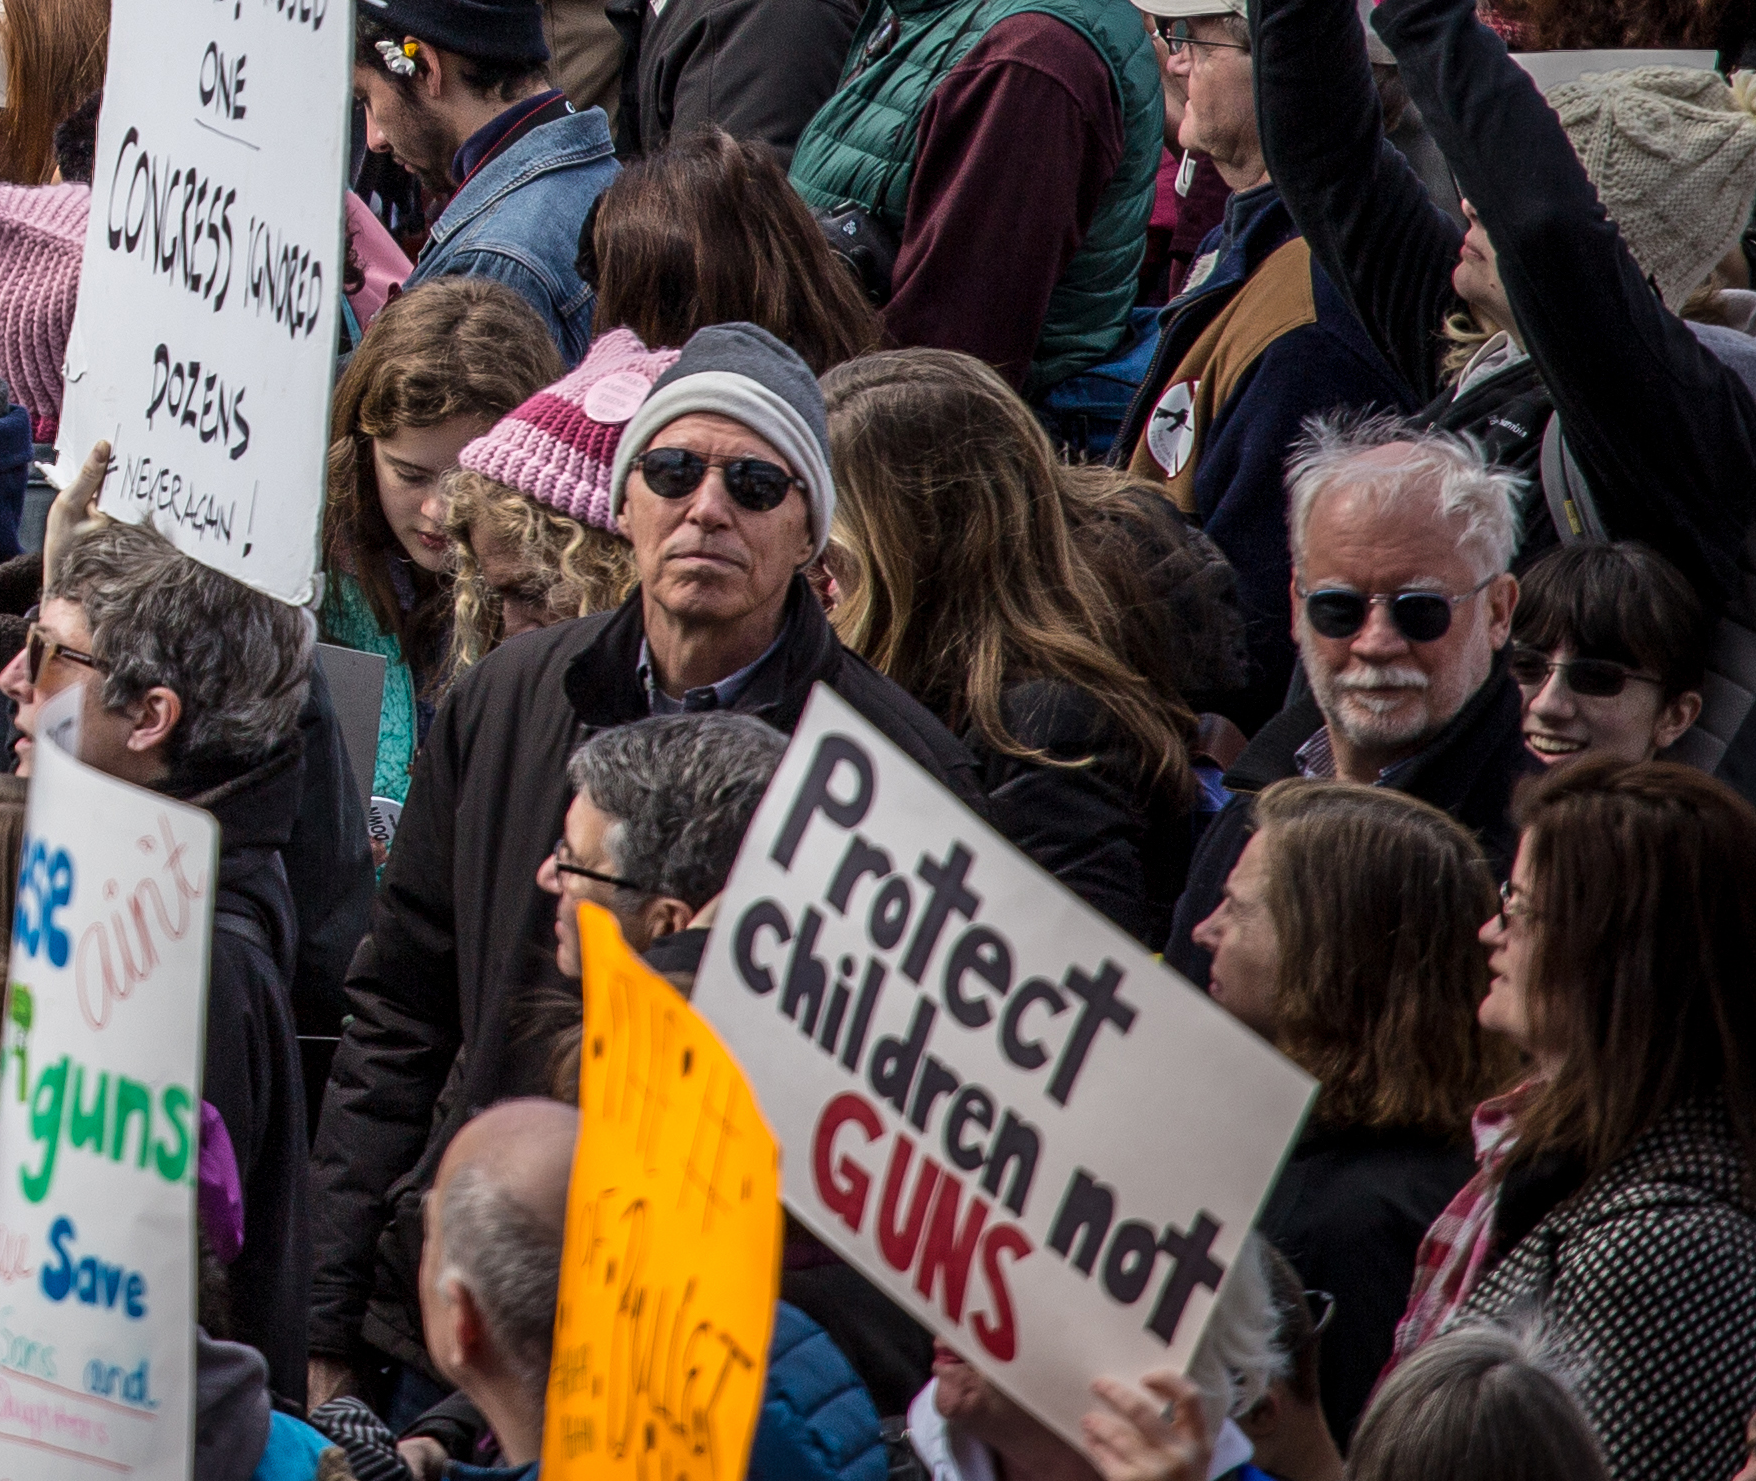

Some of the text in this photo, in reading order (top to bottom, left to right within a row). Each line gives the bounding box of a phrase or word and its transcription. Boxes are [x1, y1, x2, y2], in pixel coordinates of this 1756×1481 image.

[200, 40, 247, 120] ONE
[107, 126, 324, 340] CONGRESS IGNORED
[145, 343, 251, 461] DOZENS
[770, 730, 1140, 1109] Protect
[40, 1214, 148, 1321] Save
[810, 1091, 1034, 1363] GUNS
[1046, 1165, 1225, 1347] not
